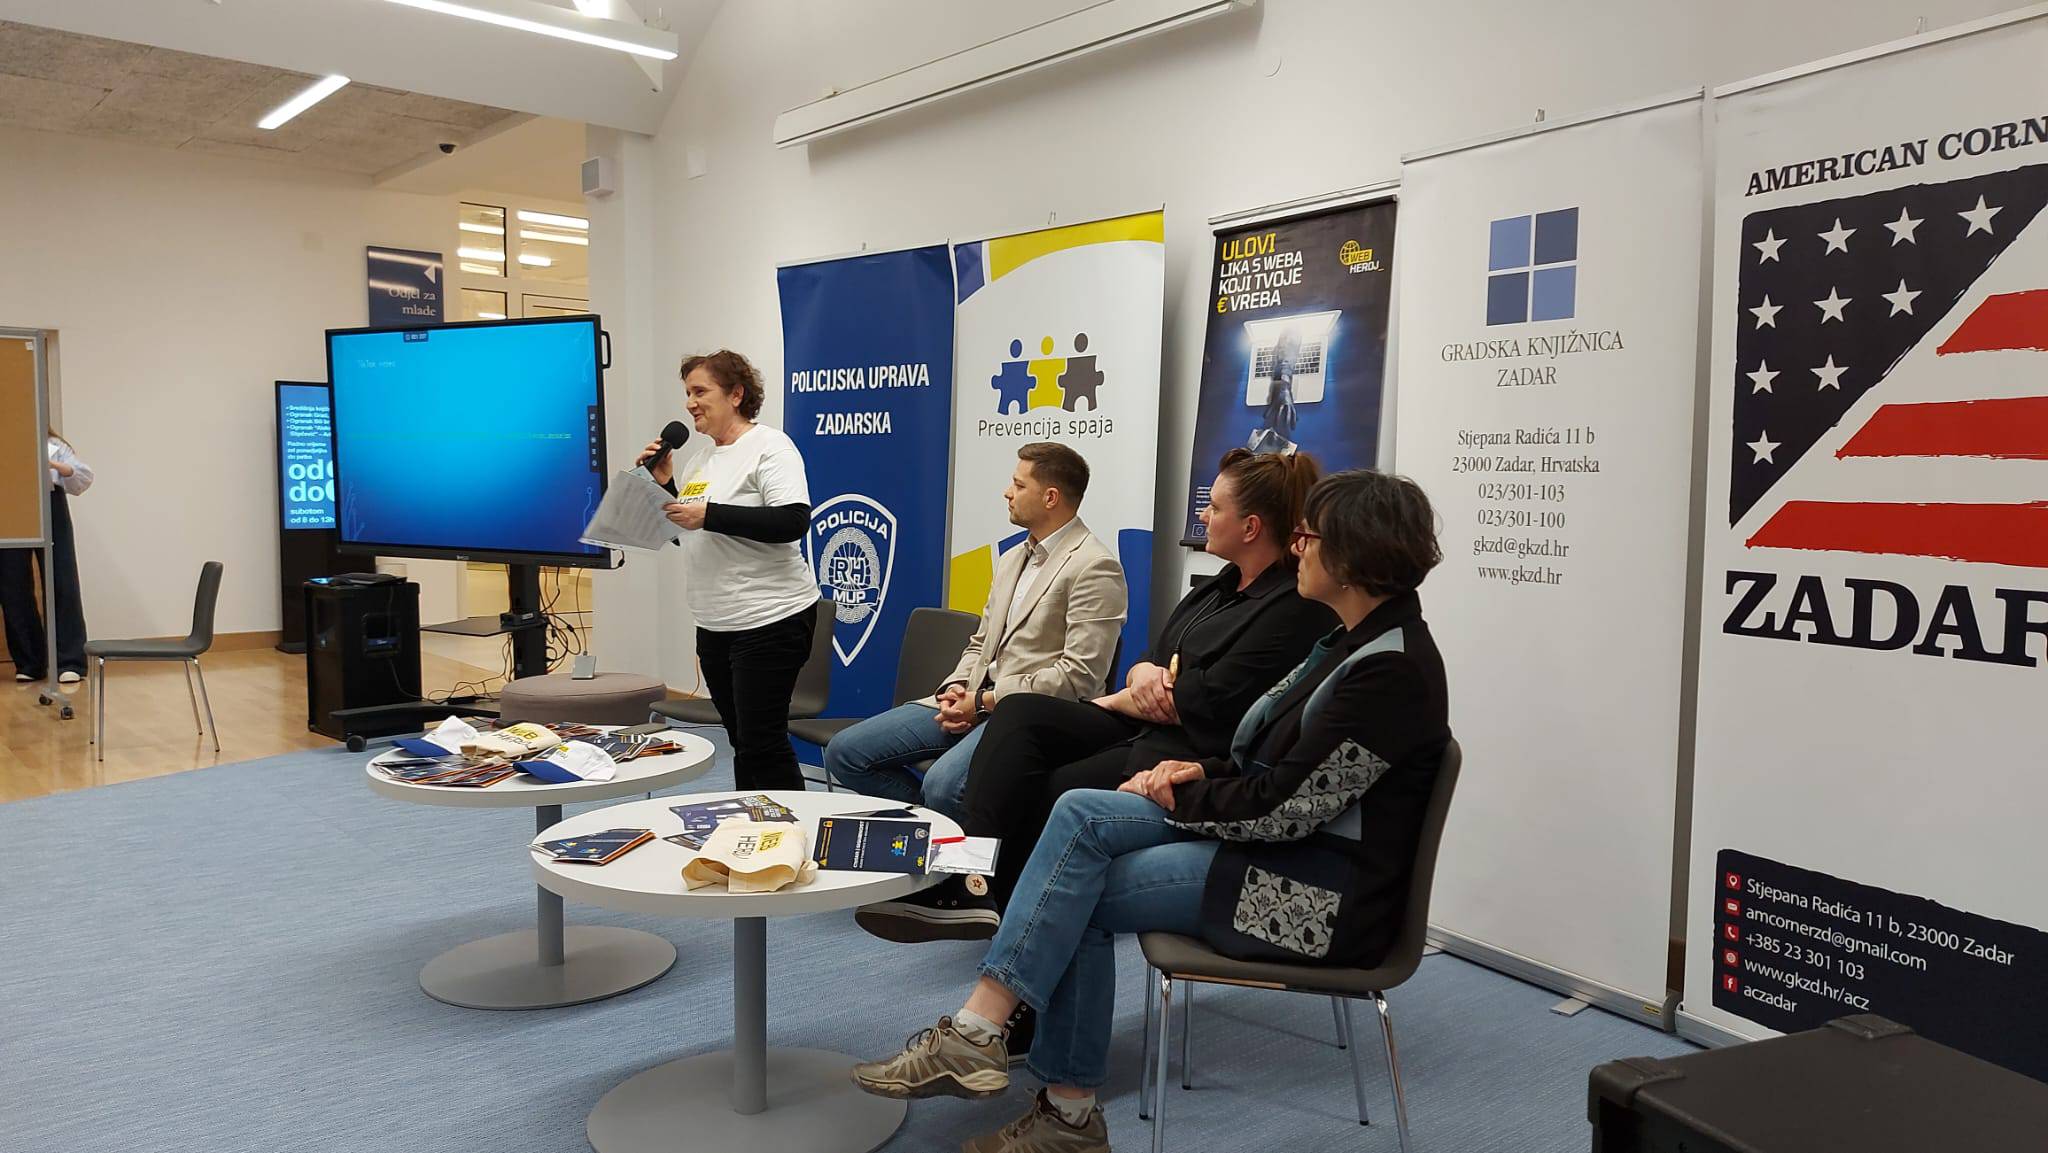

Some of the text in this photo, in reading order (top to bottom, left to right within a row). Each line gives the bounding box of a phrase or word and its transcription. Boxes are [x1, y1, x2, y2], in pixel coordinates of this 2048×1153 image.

[1744, 139, 1928, 197] AMERICAN
[1222, 233, 1276, 261] ULOVI
[1350, 251, 1370, 262] WEB
[1220, 251, 1303, 278] LIKA S WEBA
[1218, 267, 1303, 295] KOJI TVOJE
[423, 292, 437, 300] za
[1217, 289, 1281, 313] € VREBA
[402, 304, 437, 316] mlade
[1441, 329, 1624, 362] GRADSKA KNJIŽNICA
[791, 363, 930, 393] POLICIJSKA UPRAVA
[1497, 366, 1557, 387] ZADAR
[815, 411, 892, 435] ZADARSKA
[978, 415, 1113, 439] Prevencija spaja
[1457, 426, 1595, 449] Stjepana Radića 11 b
[289, 459, 324, 480] od
[1452, 455, 1600, 475] 23000 Zadar, Hrvatska
[289, 480, 325, 502] do
[682, 482, 708, 496] WEB
[1478, 483, 1565, 502] 023/301-103
[816, 510, 888, 540] POLICIJA
[1477, 509, 1566, 528] 023/301-100
[1473, 535, 1570, 559] gkzd@gkzd.hr
[833, 556, 867, 585] RH
[1477, 565, 1563, 585] www.gkzd.hr
[832, 589, 867, 604] MUP
[1722, 570, 2048, 668] ZADAR
[1746, 878, 2016, 967] Stjepana Radića 11 b, 23000 Zadar
[1745, 906, 1927, 972] amcornerzd@gmail.com
[1745, 933, 1865, 981] +385 23 301 103
[1744, 958, 1871, 1011] www.gkzd.hr/acz
[1743, 983, 1798, 1014] aczadar
